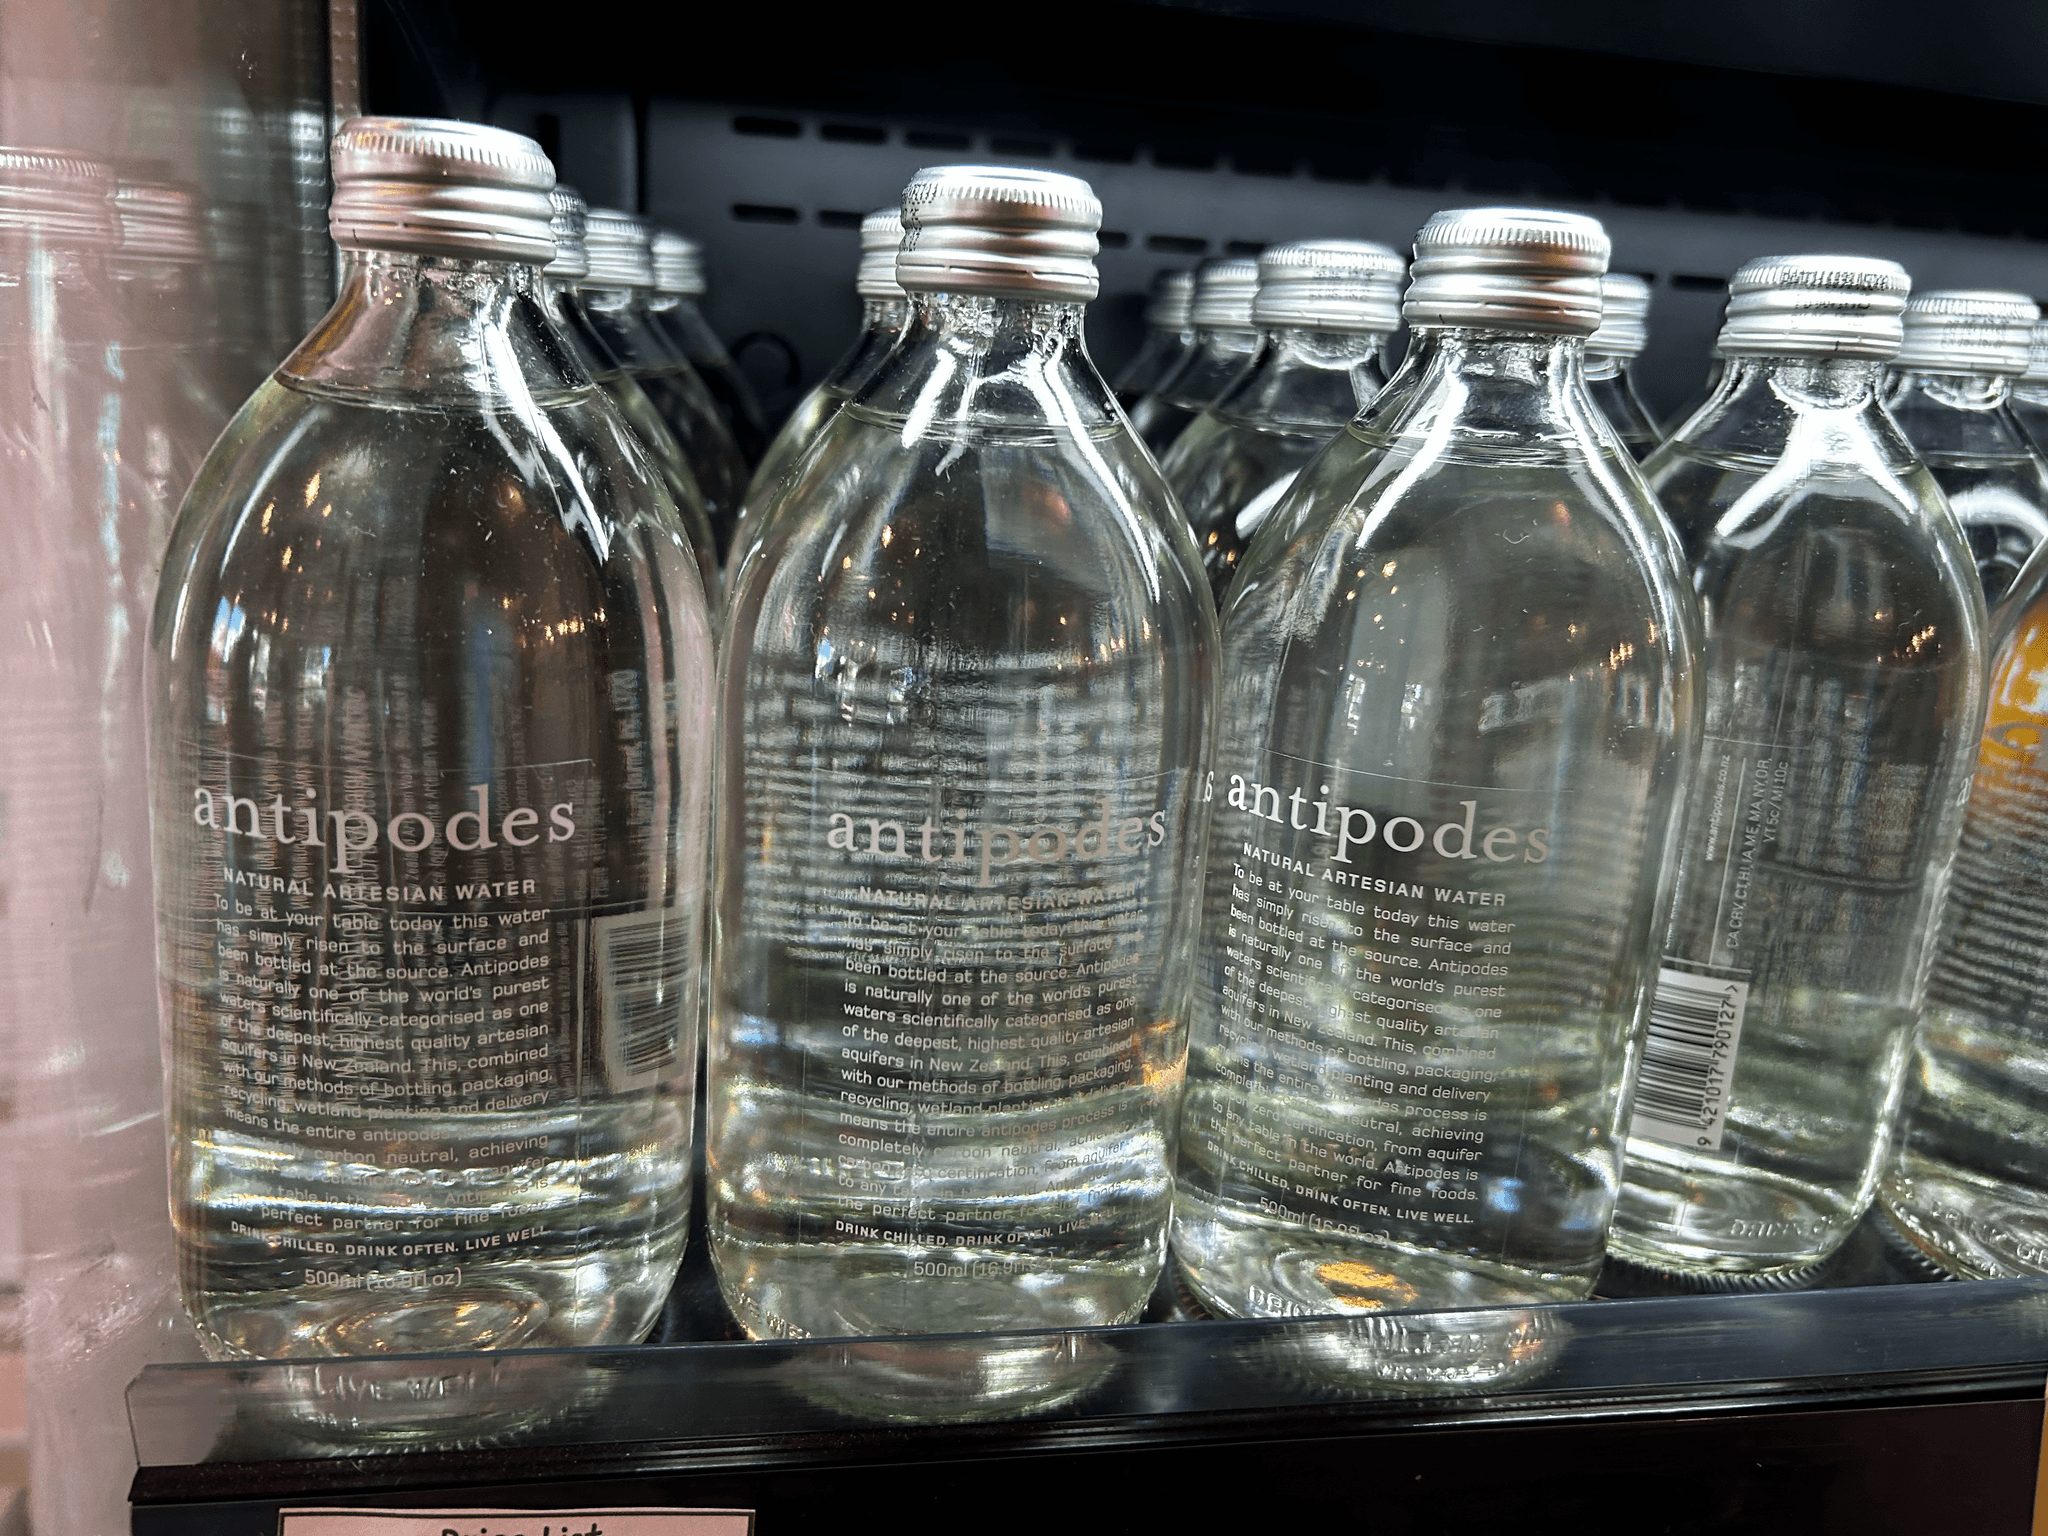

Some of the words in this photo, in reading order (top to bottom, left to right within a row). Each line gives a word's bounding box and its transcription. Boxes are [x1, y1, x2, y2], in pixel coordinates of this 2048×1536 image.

[1227, 773, 1553, 865] antipodes
[1704, 754, 1731, 862] www.antipodes.co.nz
[193, 783, 577, 875] antipodes
[827, 799, 1167, 888] antipodes
[224, 866, 314, 897] NATURAL
[322, 884, 444, 902] ARTESIAN
[455, 879, 536, 900] WATER
[1243, 841, 1316, 878] NATURAL
[1321, 867, 1424, 899] ARTESIAN
[1434, 887, 1506, 907] WATER
[1233, 862, 1245, 879] To
[1249, 870, 1263, 886] be
[1288, 887, 1319, 903] your
[1327, 895, 1365, 915] table
[1373, 905, 1419, 927] today
[1427, 914, 1460, 930] this
[1468, 920, 1516, 933] water
[390, 916, 442, 933] today
[453, 914, 489, 929] this
[498, 908, 550, 925] water
[1232, 883, 1250, 903] has
[1256, 897, 1294, 920] simply
[1373, 927, 1400, 943] the
[1410, 935, 1473, 953] surface
[1483, 942, 1511, 955] and
[249, 928, 295, 948] simply
[306, 936, 349, 952] risen
[393, 941, 424, 955] the
[437, 938, 507, 955] surface
[519, 929, 549, 947] and
[1230, 903, 1254, 925] been
[1258, 916, 1304, 943] bottled
[1309, 935, 1325, 949] at
[1332, 939, 1357, 957] the
[1364, 950, 1422, 969] source.
[1428, 958, 1509, 976] Antipodes
[218, 943, 248, 962] been
[255, 952, 311, 973] bottled
[347, 964, 377, 979] the
[386, 965, 453, 979] source.
[461, 955, 550, 976] Antipodes
[846, 955, 881, 975] been
[888, 963, 946, 983] bottled
[954, 969, 973, 983] at
[980, 969, 1008, 984] the
[1015, 967, 1070, 984] source.
[1241, 933, 1291, 962] naturally
[1298, 955, 1323, 969] one
[1355, 967, 1381, 983] the
[1391, 976, 1445, 993] world's
[1454, 984, 1506, 997] purest
[236, 974, 299, 998] naturally
[310, 986, 338, 1000] one
[380, 989, 409, 1003] the
[419, 986, 482, 1003] world's
[493, 976, 551, 999] purest
[844, 979, 857, 994] is
[865, 984, 932, 1007] naturally
[942, 994, 972, 1006] one
[980, 991, 999, 1006] of
[1007, 991, 1034, 1006] the
[1042, 984, 1091, 1004] world's
[1226, 945, 1262, 970] waters
[1475, 1007, 1502, 1018] one
[272, 1005, 371, 1028] scientifically
[380, 1008, 484, 1029] categorised
[519, 1002, 549, 1017] one
[843, 1002, 896, 1023] waters
[902, 1011, 999, 1031] scientifically
[1005, 1004, 1092, 1029] categorised
[1222, 985, 1265, 1013] aquifers
[1284, 1010, 1312, 1030] New
[1383, 1036, 1417, 1055] This,
[1376, 1016, 1428, 1036] quality
[1712, 999, 1737, 1060] 790127
[266, 1025, 334, 1048] deepest,
[411, 1033, 470, 1051] quality
[477, 1025, 549, 1045] artesian
[842, 1024, 859, 1037] of
[863, 1026, 889, 1044] the
[894, 1032, 962, 1053] deepest,
[968, 1035, 1026, 1053] highest
[467, 1044, 549, 1070] combined
[841, 1047, 904, 1068] aquifers
[929, 1057, 963, 1072] New
[1266, 1026, 1324, 1054] methods
[1348, 1049, 1410, 1075] bottling,
[1414, 1064, 1497, 1083] packaging,
[284, 1076, 353, 1095] methods
[384, 1078, 456, 1096] bottling,
[462, 1068, 553, 1095] packaging,
[841, 1069, 872, 1085] with
[877, 1076, 904, 1089] our
[908, 1080, 977, 1094] methods
[1399, 1084, 1428, 1097] and
[1432, 1085, 1491, 1104] delivery
[295, 1102, 362, 1118] wetland
[485, 1090, 549, 1112] delivery
[840, 1090, 913, 1115] recycling,
[1701, 1065, 1725, 1127] 421017
[226, 1107, 268, 1129] means
[274, 1119, 299, 1134] the
[306, 1124, 356, 1141] entire
[839, 1111, 889, 1130] means
[1404, 1104, 1469, 1121] process
[838, 1133, 924, 1158] completely
[1412, 1126, 1484, 1143] achieving
[1697, 1136, 1712, 1146] 9
[387, 1147, 458, 1166] neutral,
[469, 1134, 549, 1159] achieving
[1334, 1152, 1378, 1171] world.
[1383, 1140, 1422, 1157] from
[1427, 1149, 1483, 1162] aquifer
[1232, 1134, 1281, 1163] perfect
[1288, 1158, 1348, 1183] partner
[1356, 1175, 1382, 1191] for
[1390, 1181, 1422, 1197] fine
[1431, 1186, 1479, 1200] foods.
[1239, 1161, 1290, 1190] CHILLED.
[1295, 1184, 1339, 1206] DRINK
[1343, 1198, 1391, 1217] OFTEN.
[1396, 1208, 1428, 1221] LIVE
[1434, 1212, 1475, 1224] WELL.
[261, 1205, 324, 1228] perfect
[872, 1203, 936, 1221] perfect
[1260, 1196, 1305, 1226] 500ml
[345, 1244, 397, 1256] DRINK
[403, 1242, 459, 1256] OFTEN.
[465, 1234, 501, 1250] LIVE
[835, 1220, 879, 1240] DRINK
[883, 1230, 949, 1246] CHILLED.
[955, 1233, 1003, 1246] DRINK
[914, 1261, 967, 1278] 500ml
